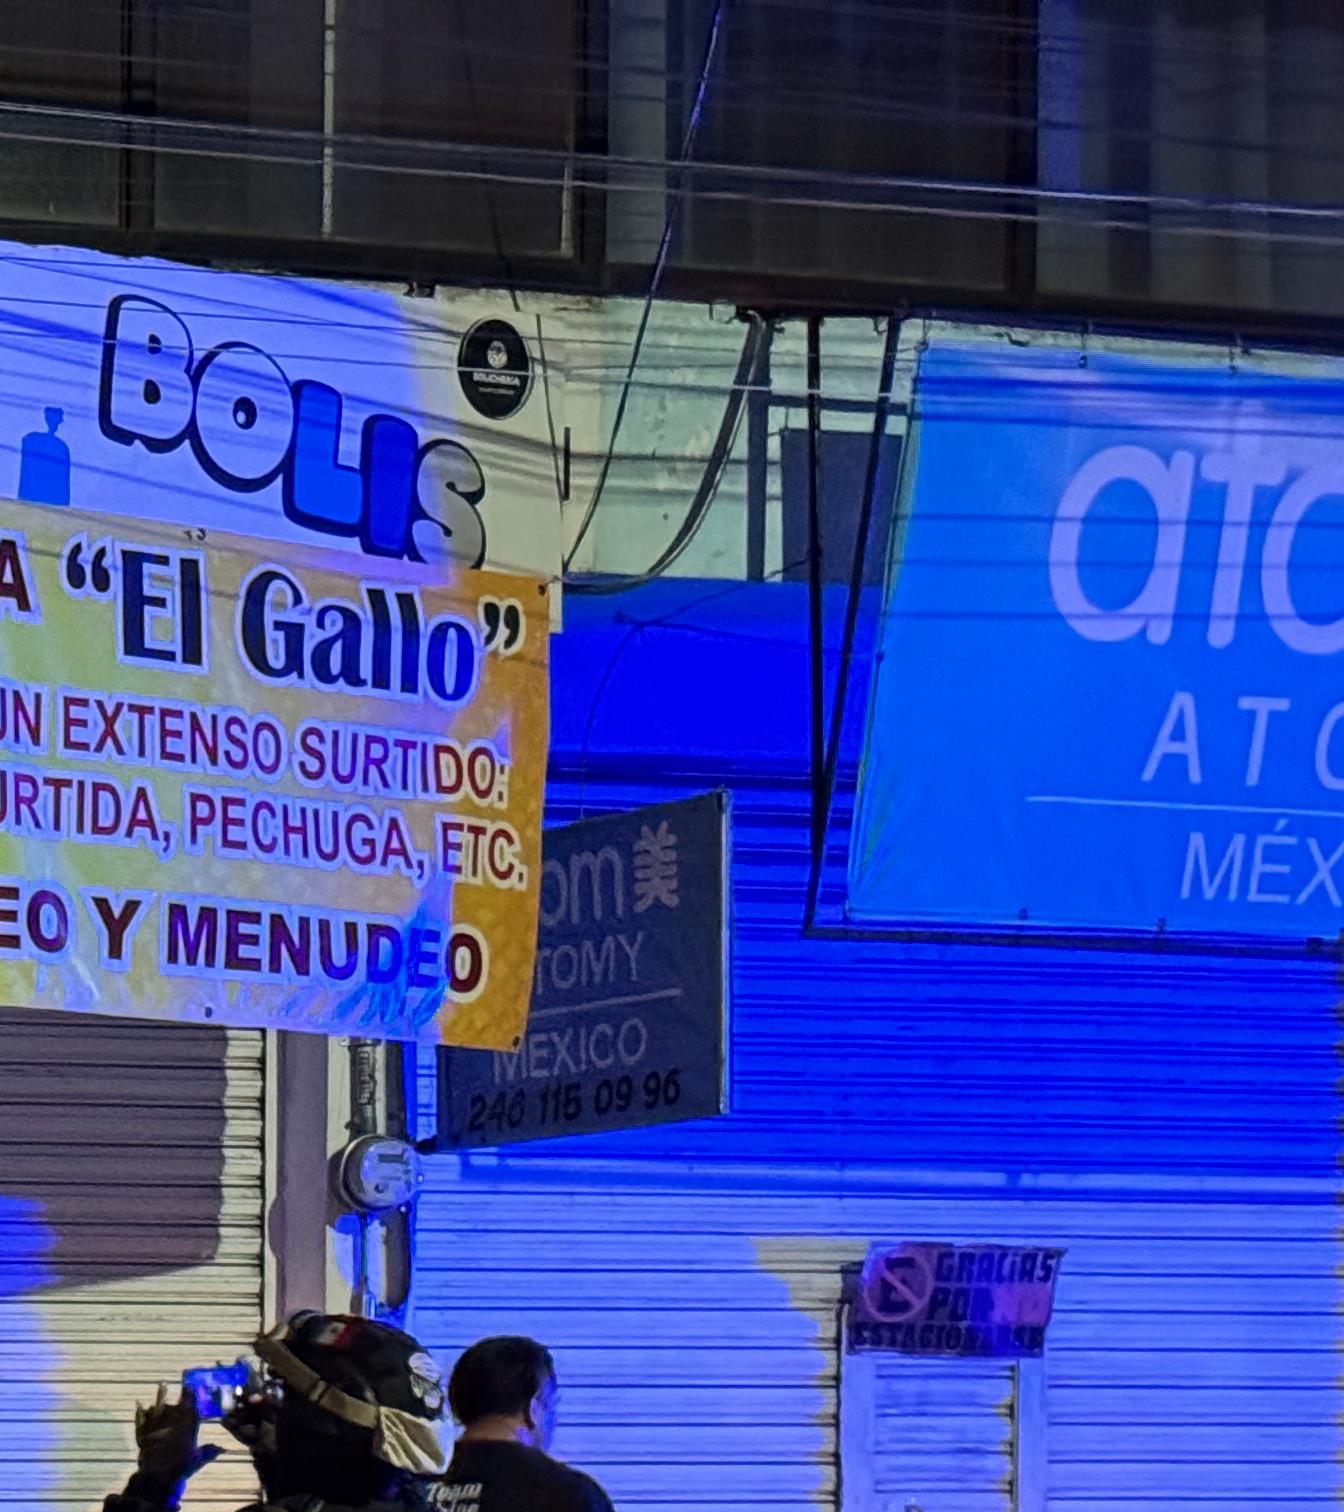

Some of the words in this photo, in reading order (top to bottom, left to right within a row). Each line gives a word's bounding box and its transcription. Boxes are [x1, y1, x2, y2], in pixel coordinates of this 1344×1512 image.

[99, 293, 486, 569] BOLIS
[62, 697, 283, 775] EXTENSO
[299, 726, 507, 802] SURTIDO:
[189, 792, 426, 880] PECHUGA,
[442, 821, 524, 883] ETC.
[91, 895, 142, 960] Y
[166, 902, 483, 993] MENUDEO
[595, 1074, 633, 1115] 09
[643, 1068, 681, 1110] 96
[926, 1286, 995, 1322] POR
[935, 1250, 1054, 1284] GRACIAS
